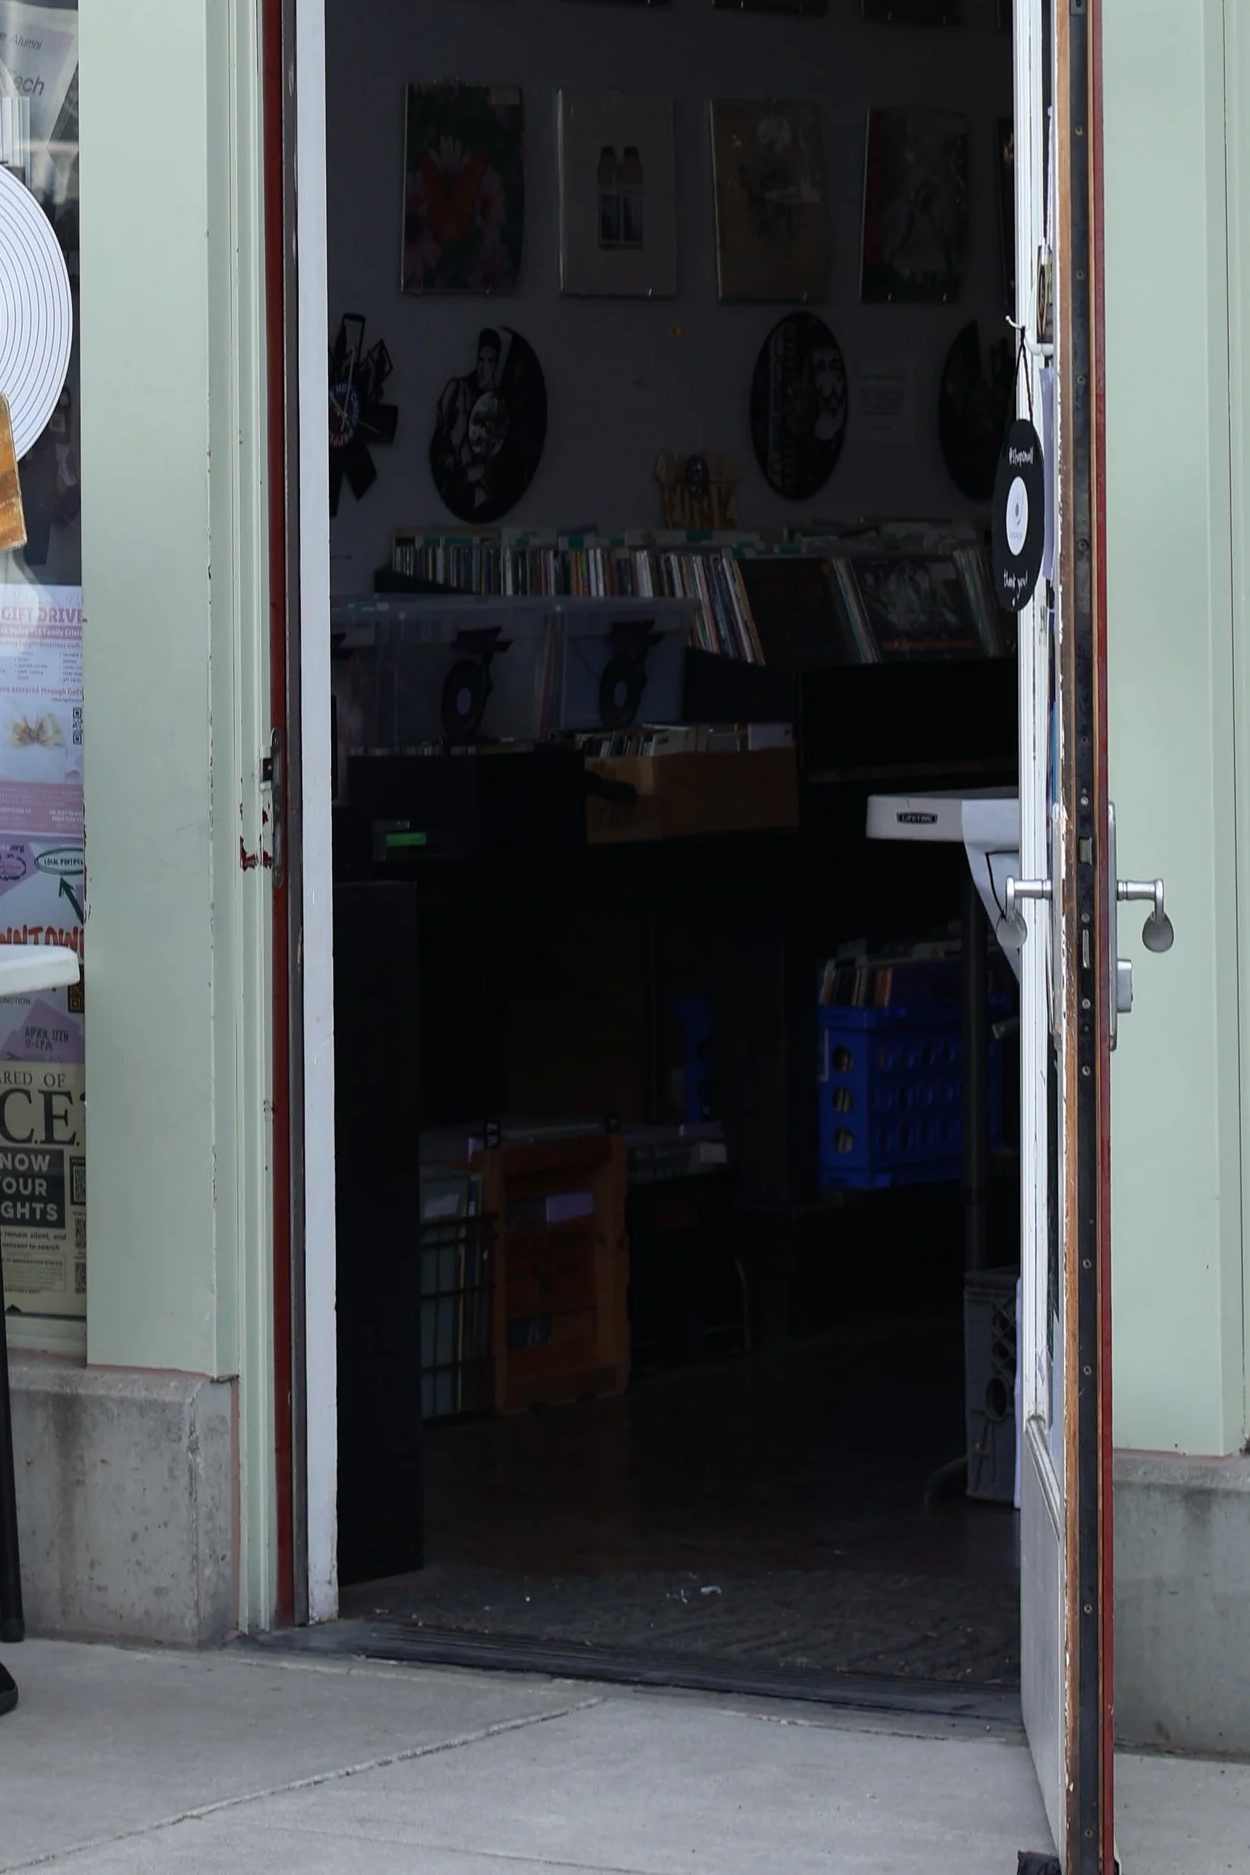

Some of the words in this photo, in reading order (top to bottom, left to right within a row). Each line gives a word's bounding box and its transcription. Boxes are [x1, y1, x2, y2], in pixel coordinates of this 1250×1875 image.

[10, 34, 43, 52] Alumni
[44, 1073, 66, 1088] OF
[0, 1152, 51, 1173] NOW
[0, 1201, 59, 1222] GHTS
